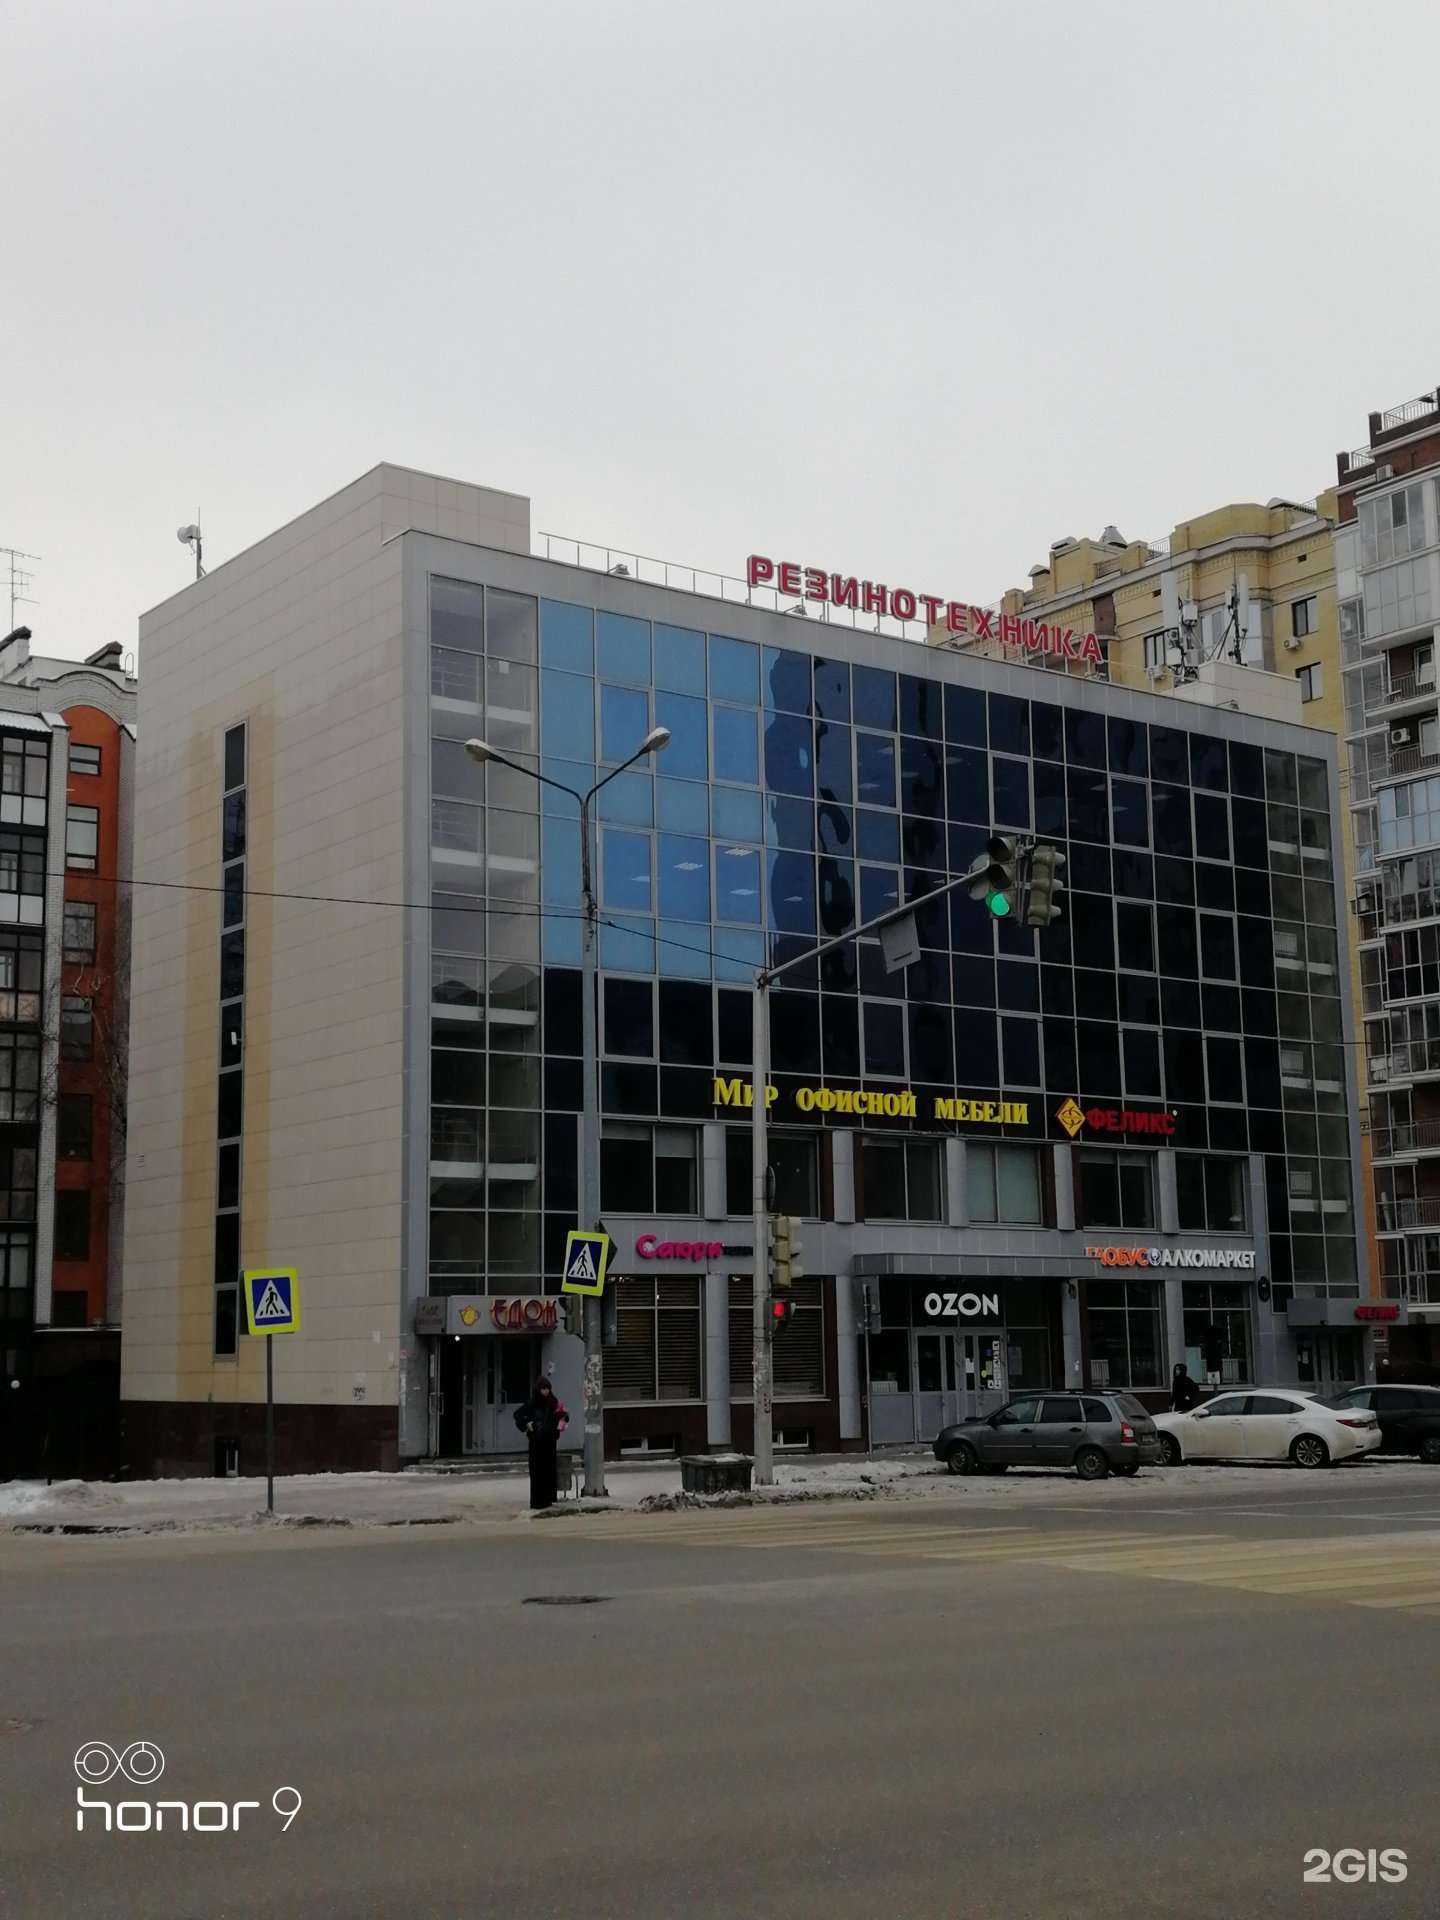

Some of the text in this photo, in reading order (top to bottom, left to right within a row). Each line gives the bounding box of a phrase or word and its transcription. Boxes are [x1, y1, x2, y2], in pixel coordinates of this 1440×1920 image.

[747, 555, 1103, 662] РЕЗИНОТЕХНИКА
[796, 1087, 917, 1118] ОФИСНОЙ
[935, 1097, 1029, 1125] МЕБЕЛИ
[1087, 1108, 1176, 1135] ФЕЛИКС
[1161, 1248, 1256, 1269] АЛКОМАРКЕТ
[924, 1292, 999, 1317] OZON
